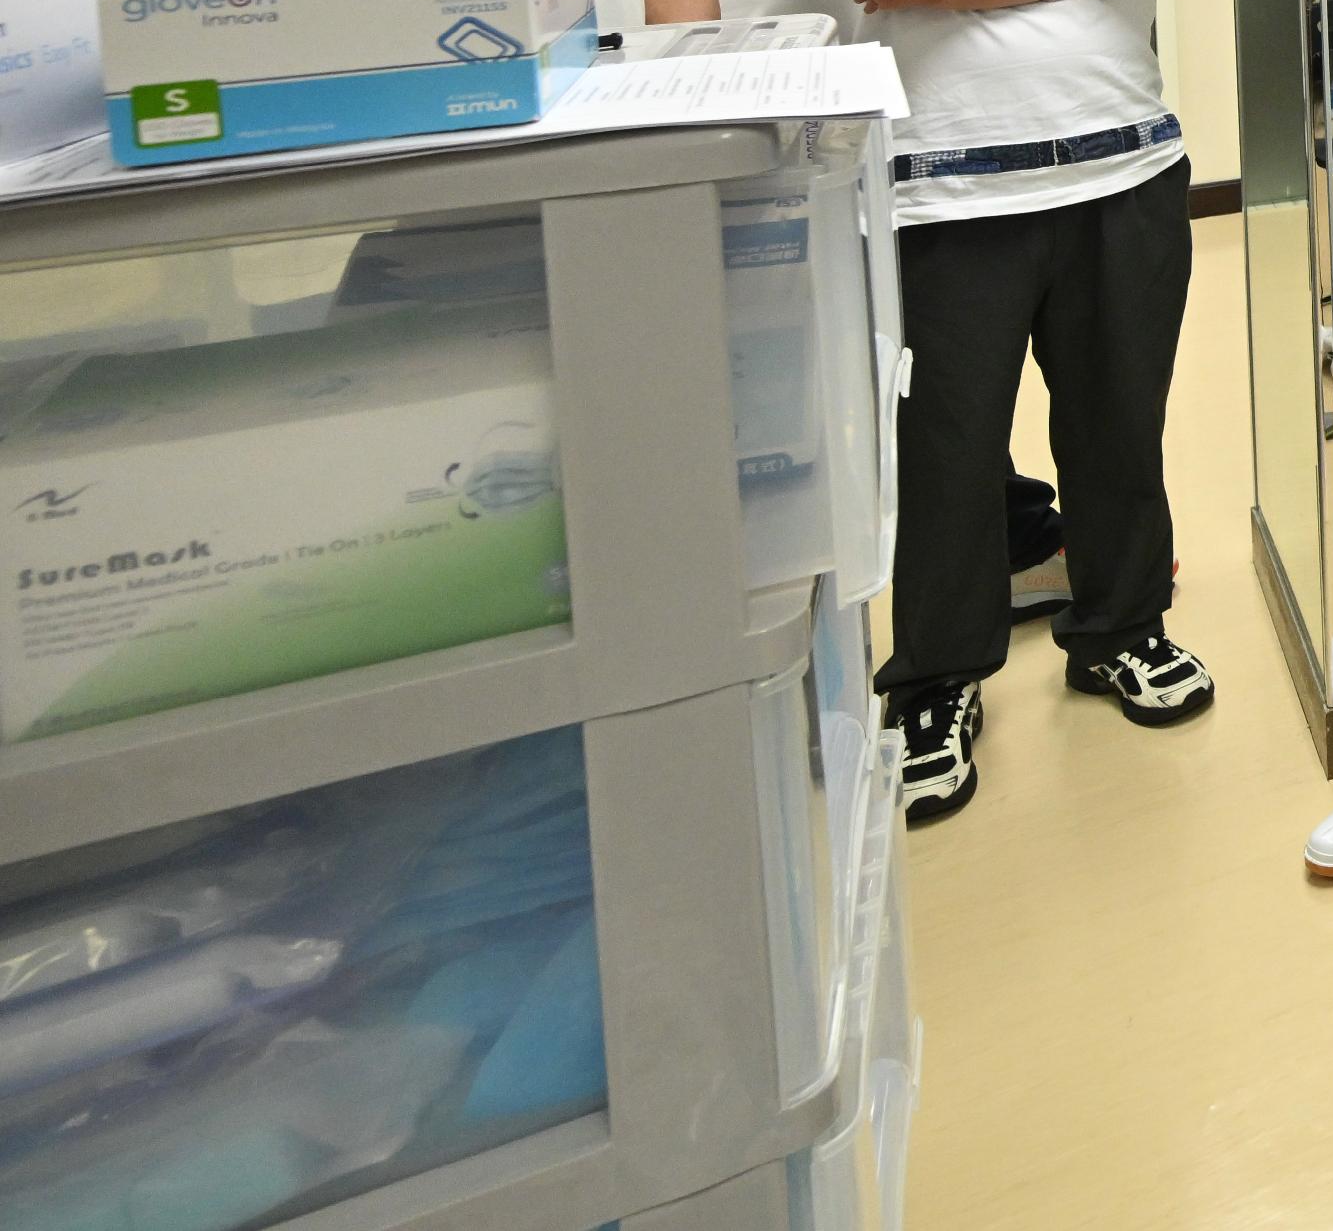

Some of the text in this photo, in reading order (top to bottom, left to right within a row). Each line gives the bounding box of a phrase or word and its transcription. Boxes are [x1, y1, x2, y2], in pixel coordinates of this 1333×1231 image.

[163, 87, 191, 113] S
[18, 540, 212, 591] SureMask
[125, 567, 211, 591] Medical
[214, 552, 280, 575] Grade
[329, 535, 361, 554] On
